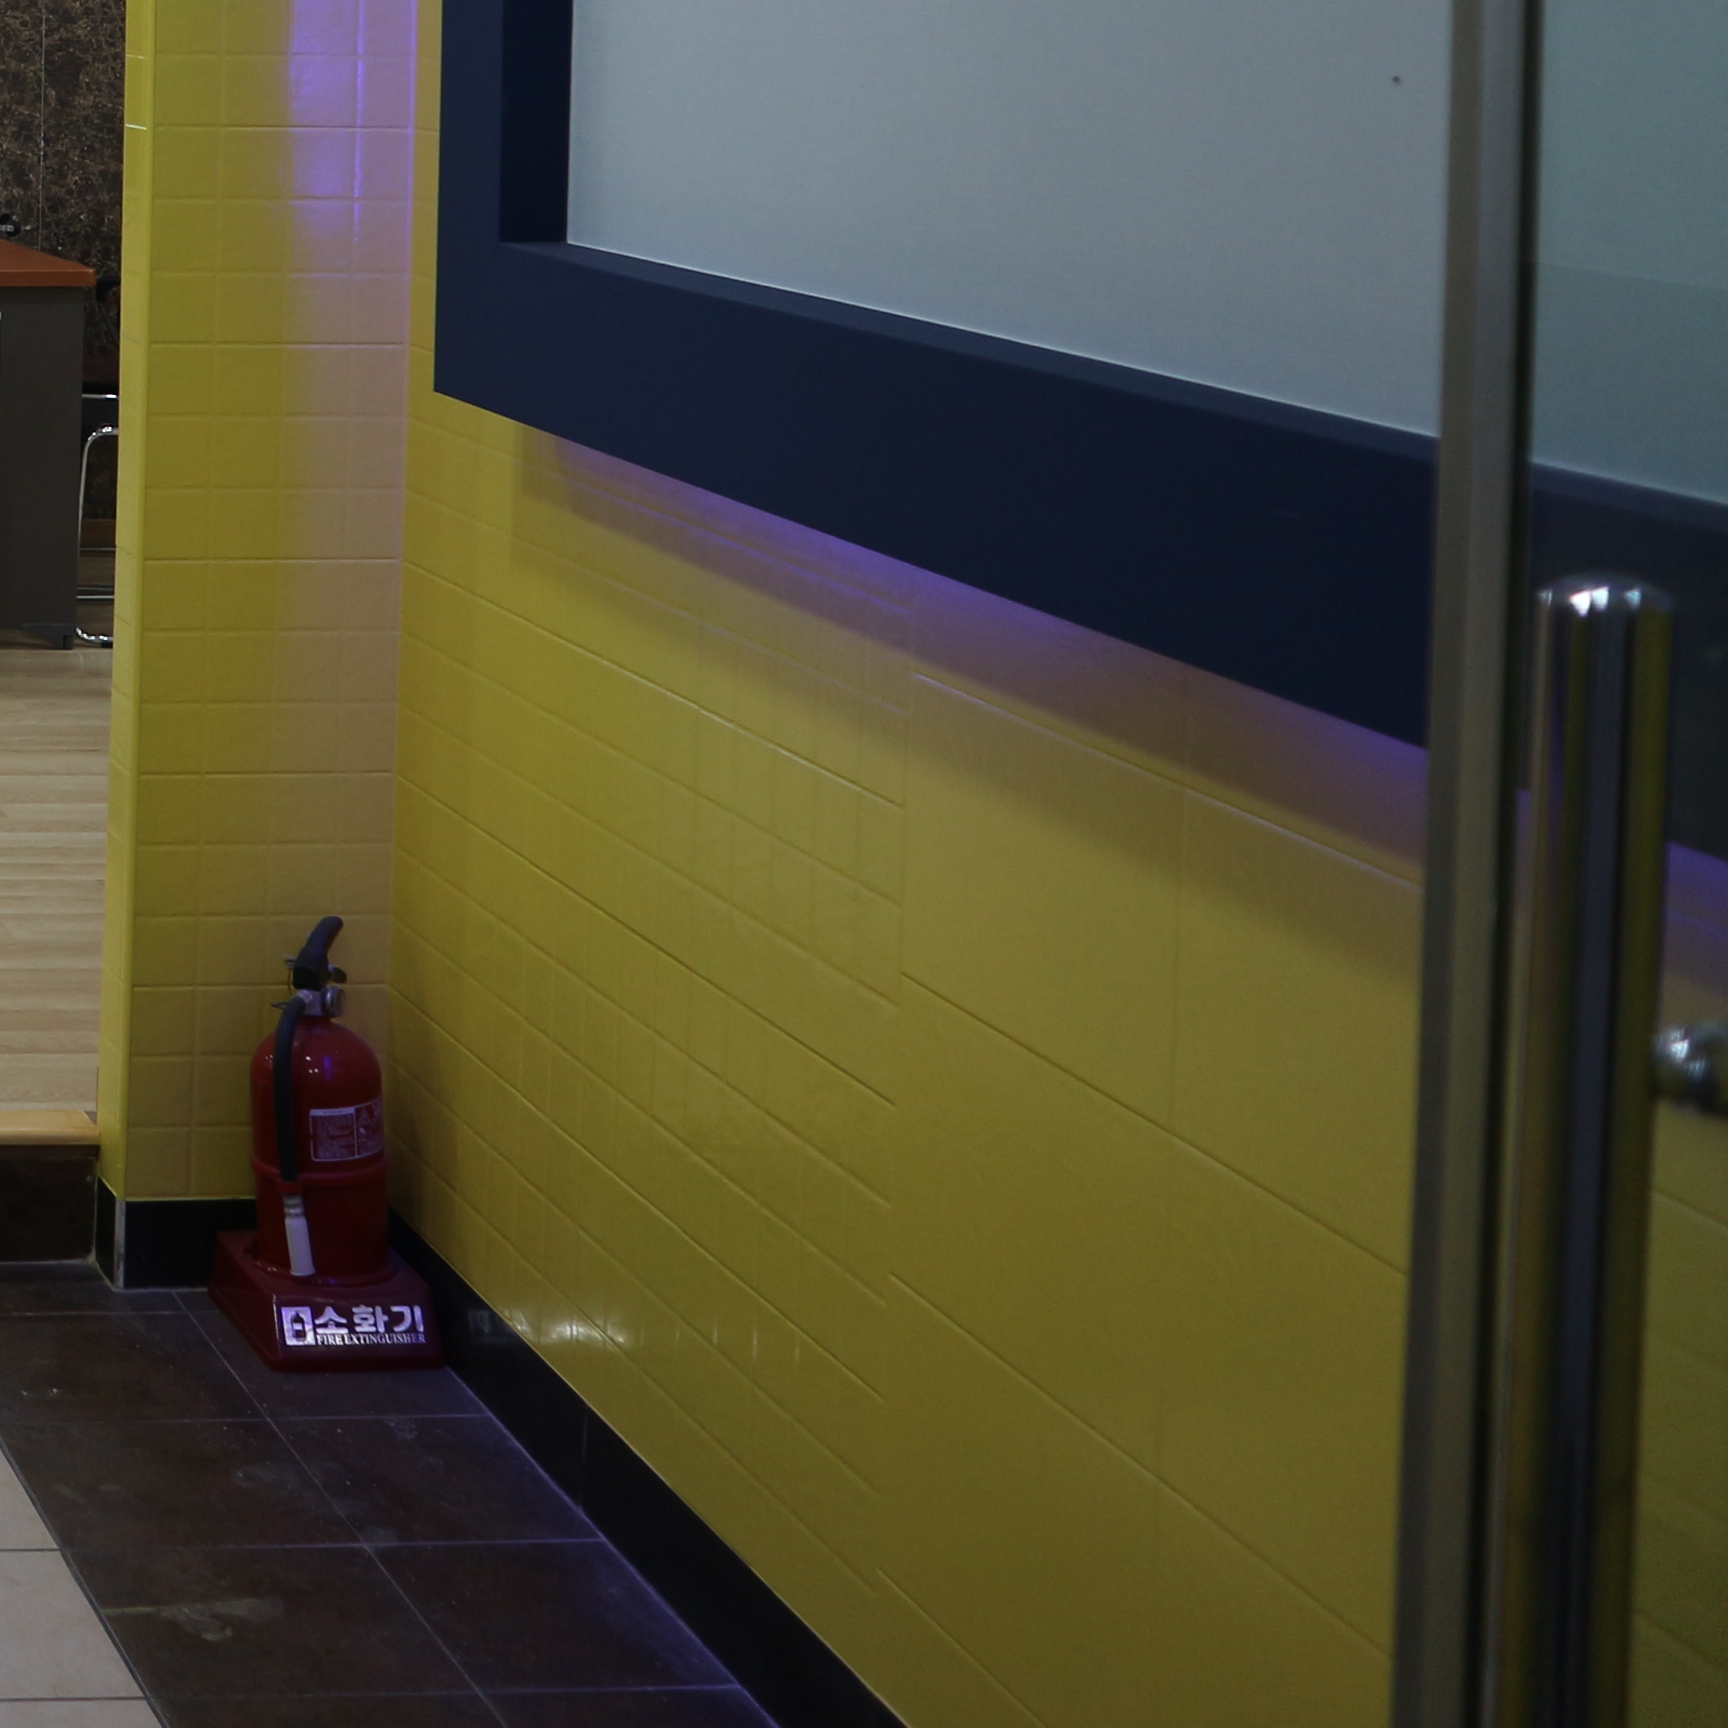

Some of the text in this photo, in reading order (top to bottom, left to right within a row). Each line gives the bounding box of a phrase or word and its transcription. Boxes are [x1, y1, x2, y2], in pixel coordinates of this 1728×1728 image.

[314, 1305, 424, 1334] 소화기
[317, 1332, 426, 1346] FIRE EXTINGUISHER
